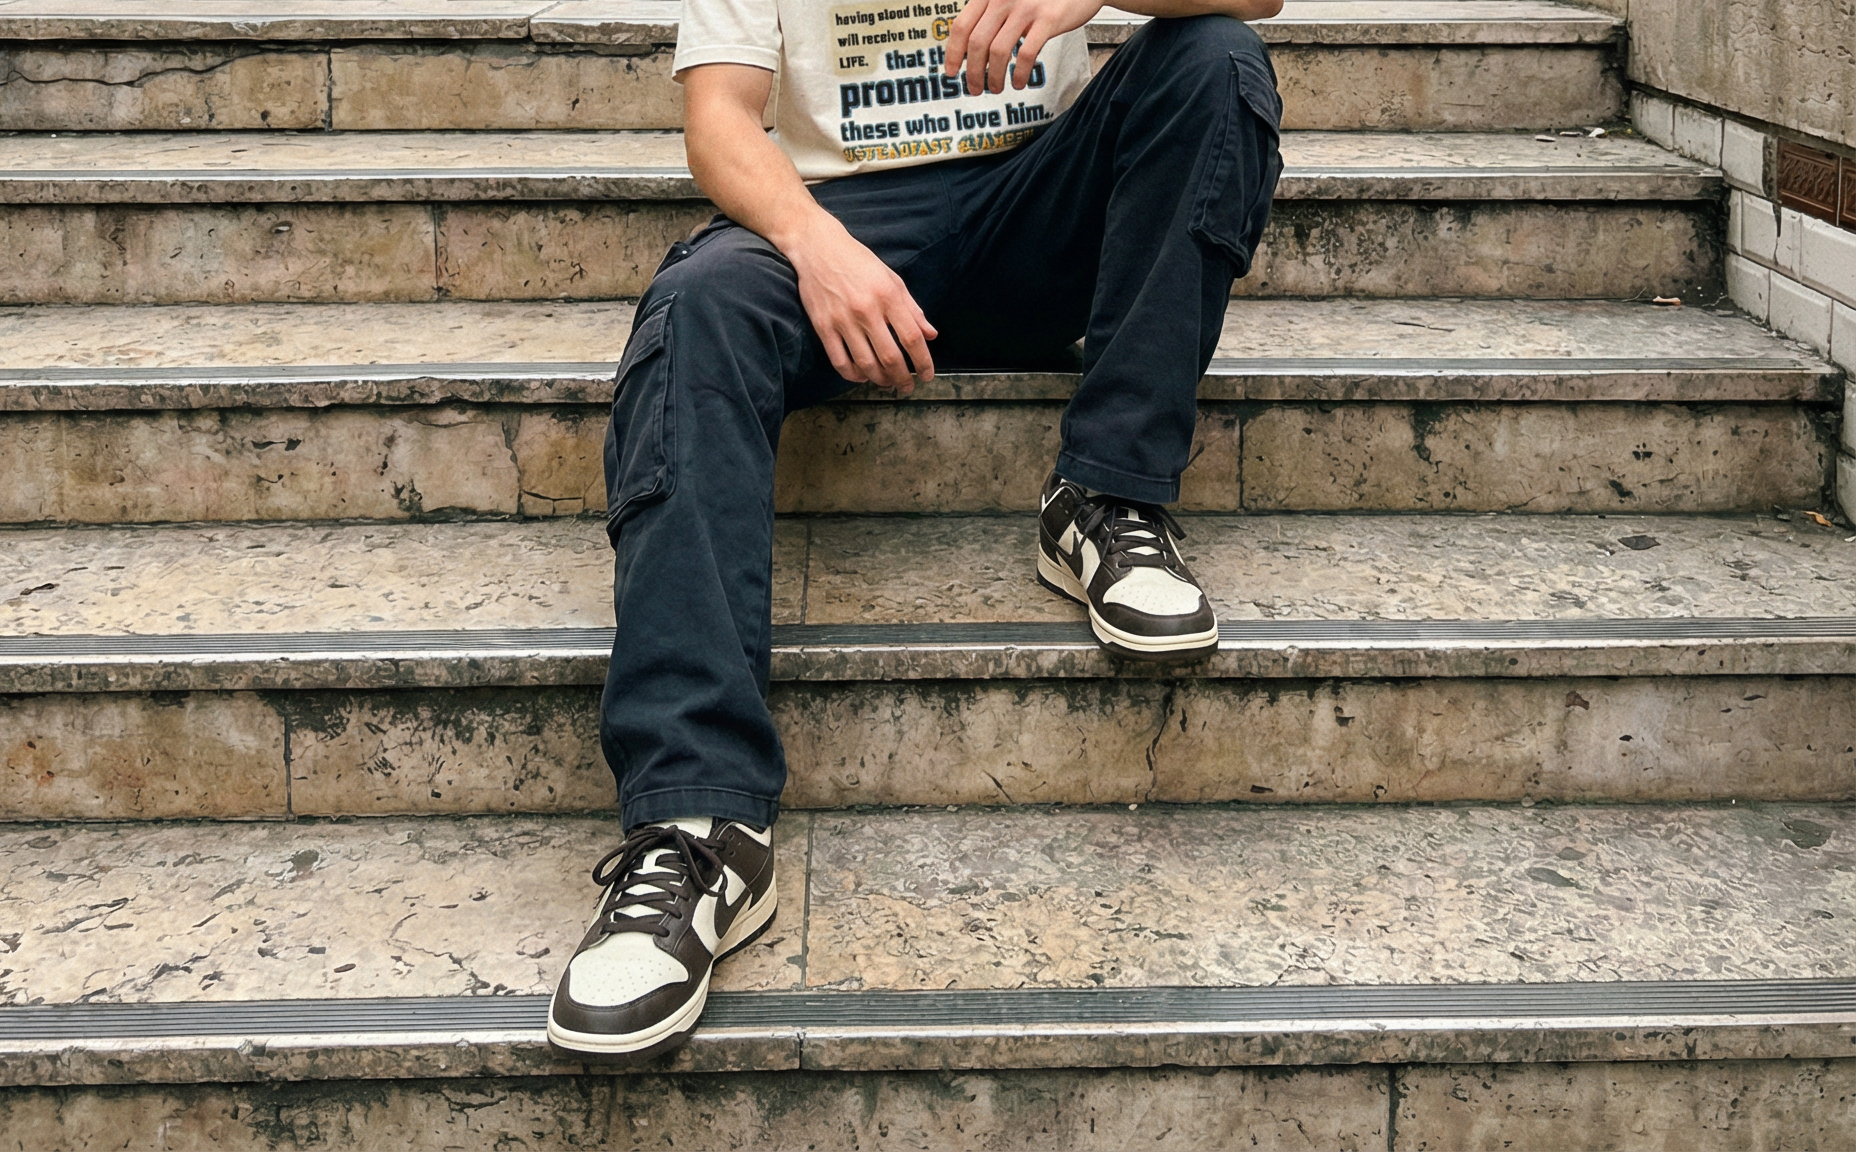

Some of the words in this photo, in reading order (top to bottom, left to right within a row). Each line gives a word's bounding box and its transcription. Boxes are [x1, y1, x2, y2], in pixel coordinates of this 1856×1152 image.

[912, 4, 932, 17] the
[837, 33, 860, 47] will
[862, 30, 905, 45] receive
[907, 27, 927, 40] the
[885, 48, 926, 71] that
[840, 120, 900, 142] these
[904, 113, 951, 136] who
[954, 109, 1001, 131] love
